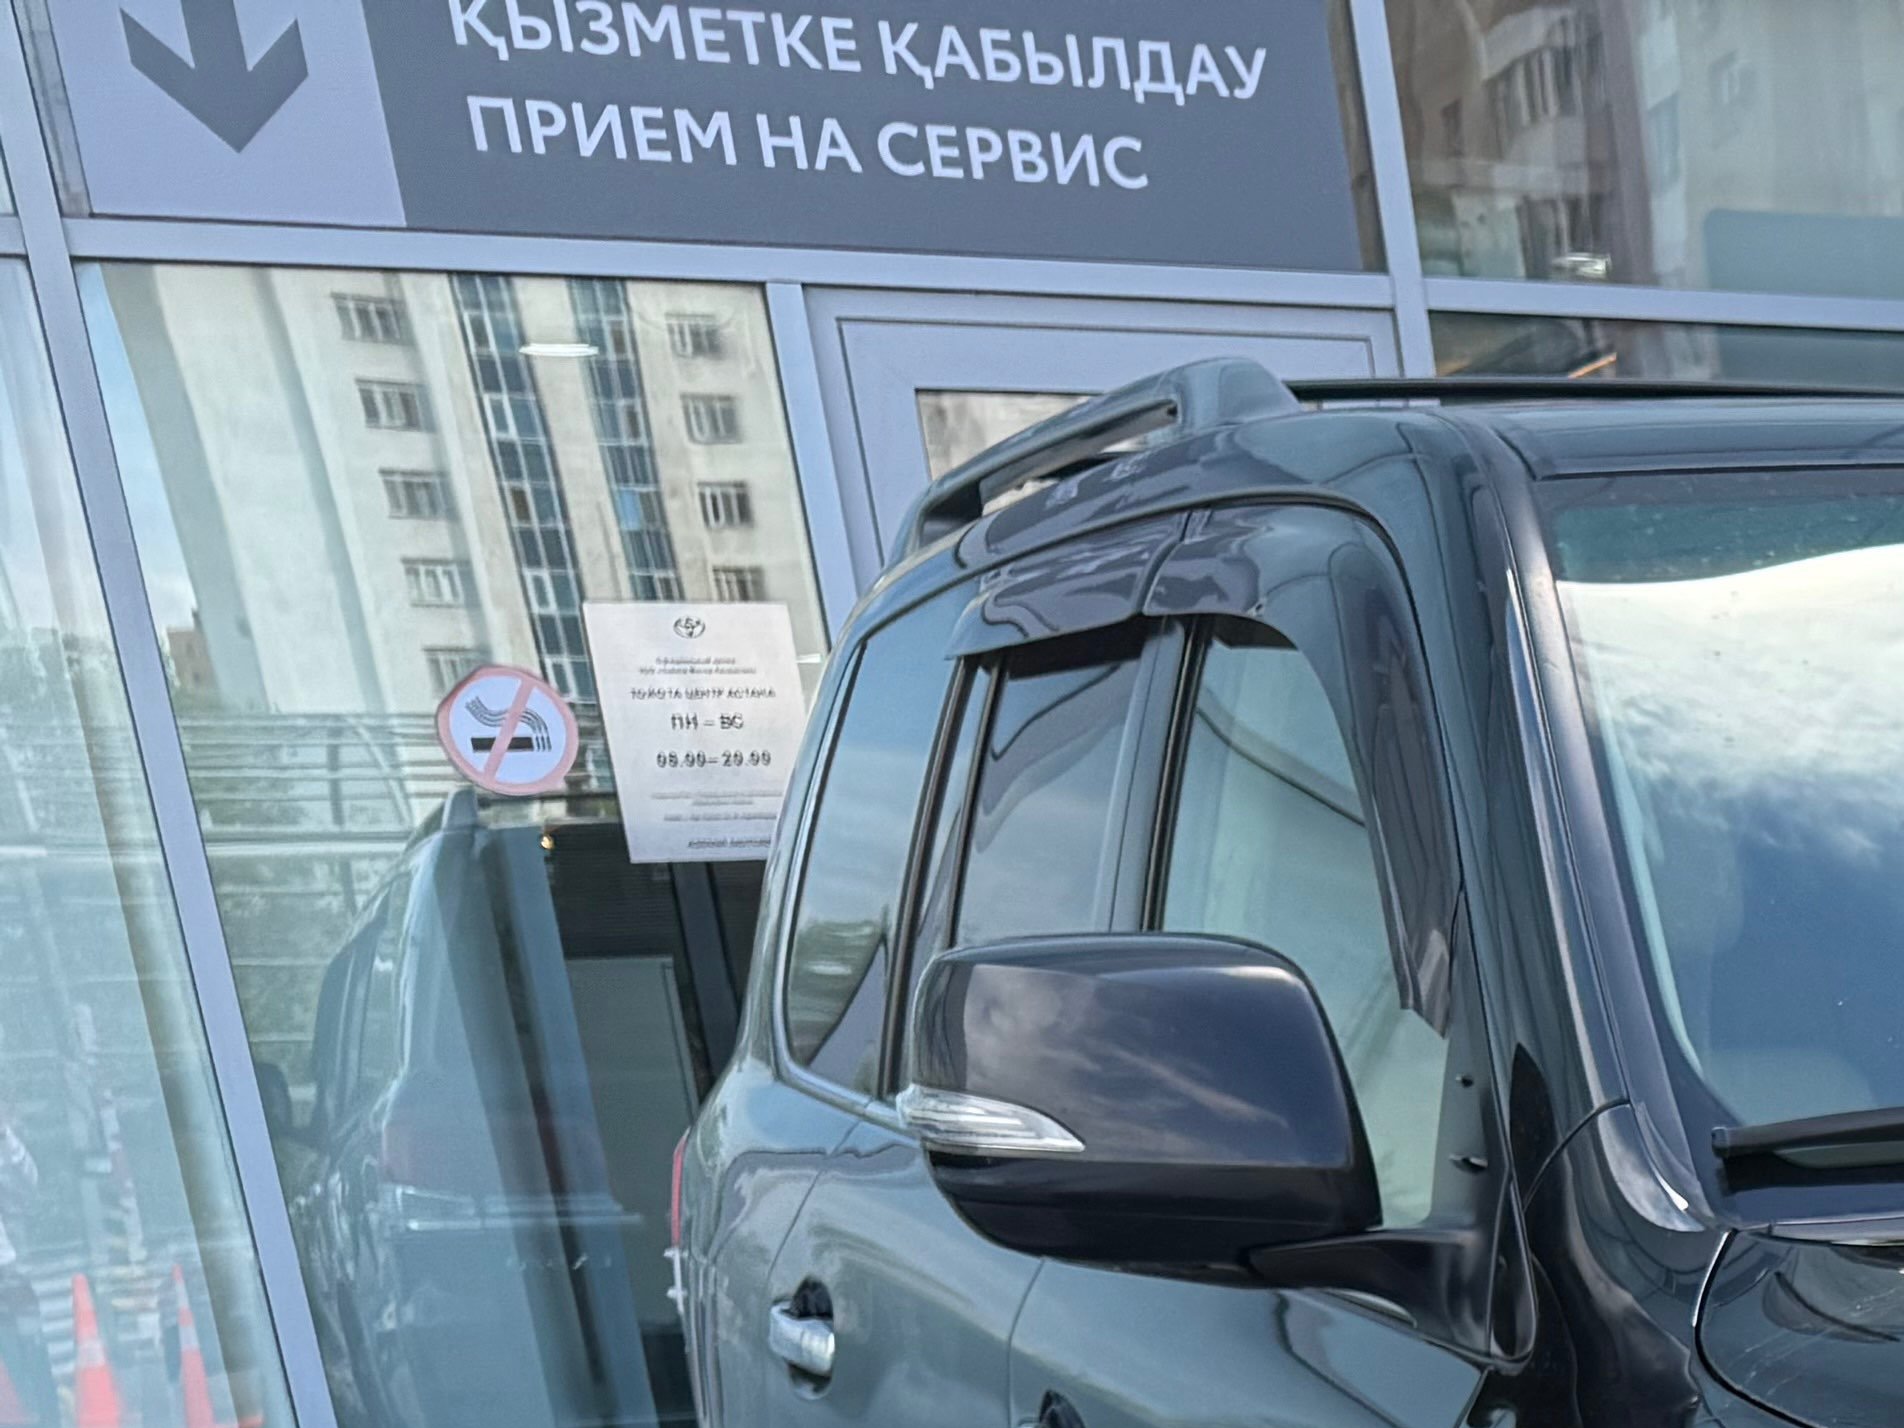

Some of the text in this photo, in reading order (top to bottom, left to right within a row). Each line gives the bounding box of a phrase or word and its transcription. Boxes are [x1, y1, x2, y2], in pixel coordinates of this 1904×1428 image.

[447, 0, 1267, 107] ҚЫЗМЕТКЕ ҚАБЫЛДАУ
[466, 95, 1149, 190] ПРИЕМ НА СЕРВИС
